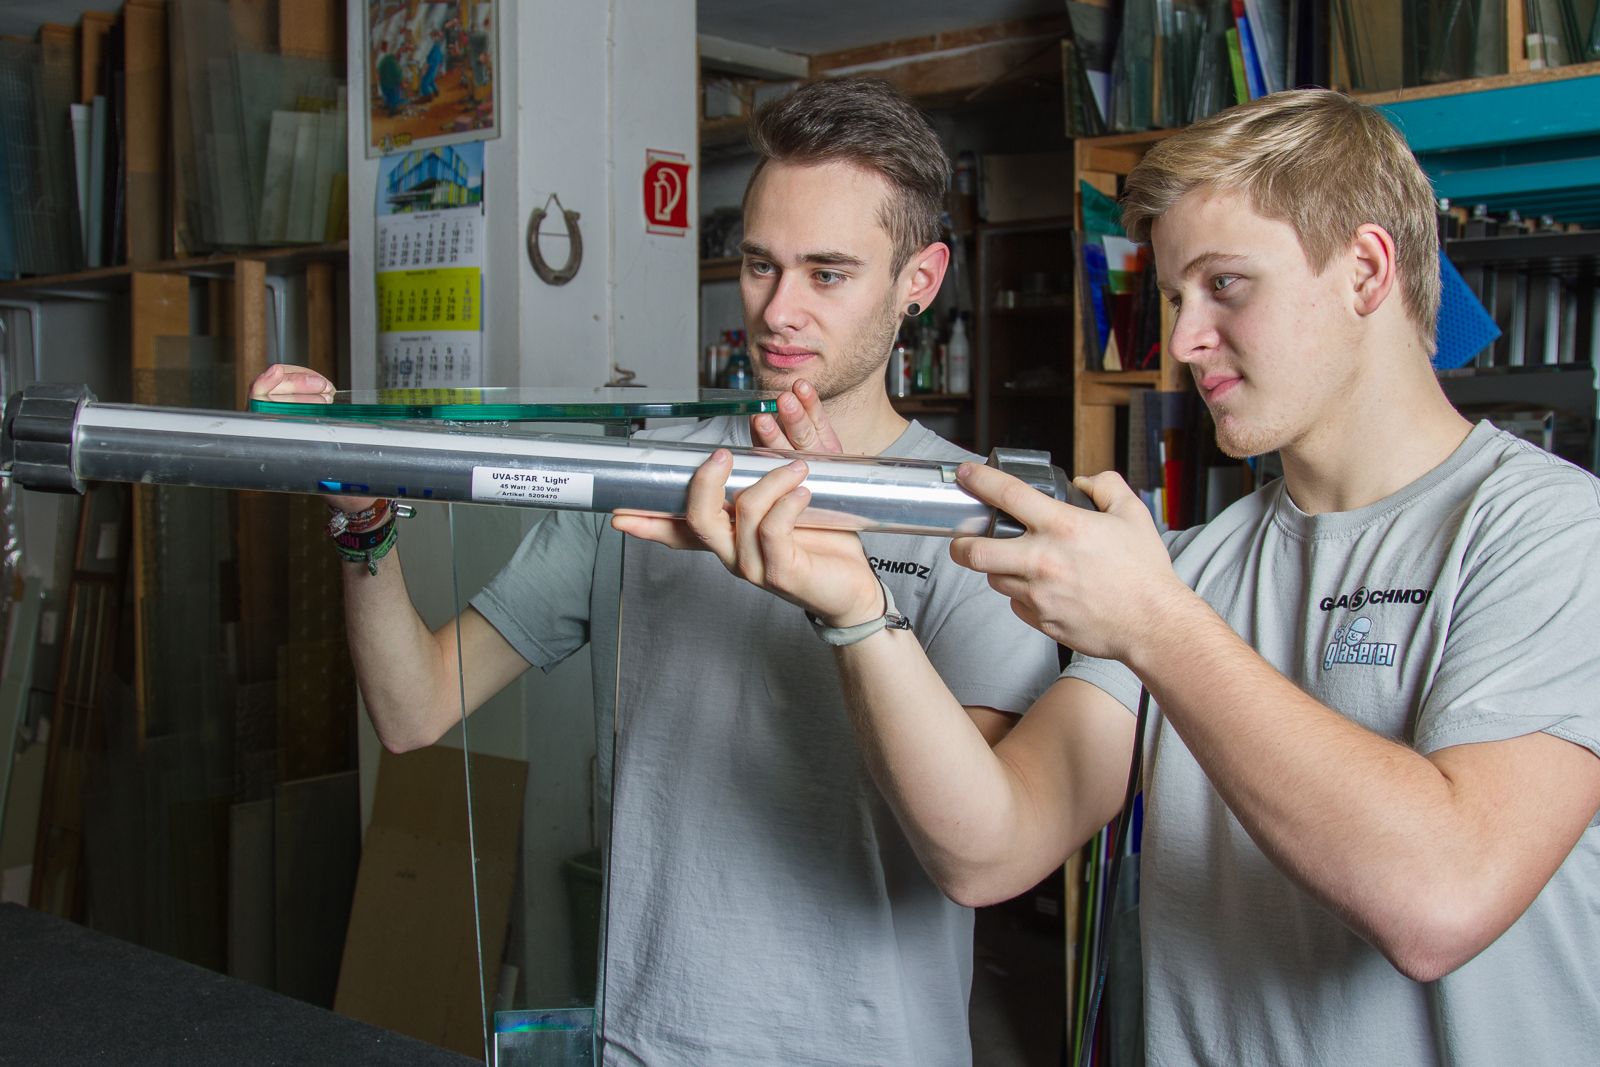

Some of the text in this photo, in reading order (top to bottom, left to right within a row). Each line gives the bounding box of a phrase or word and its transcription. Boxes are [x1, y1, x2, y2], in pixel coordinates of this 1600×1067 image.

[492, 472, 538, 483] UVA-STAR
[868, 556, 931, 580] CHMOZ
[1320, 587, 1433, 612] GASCHMO
[1323, 640, 1397, 671] glaserei
